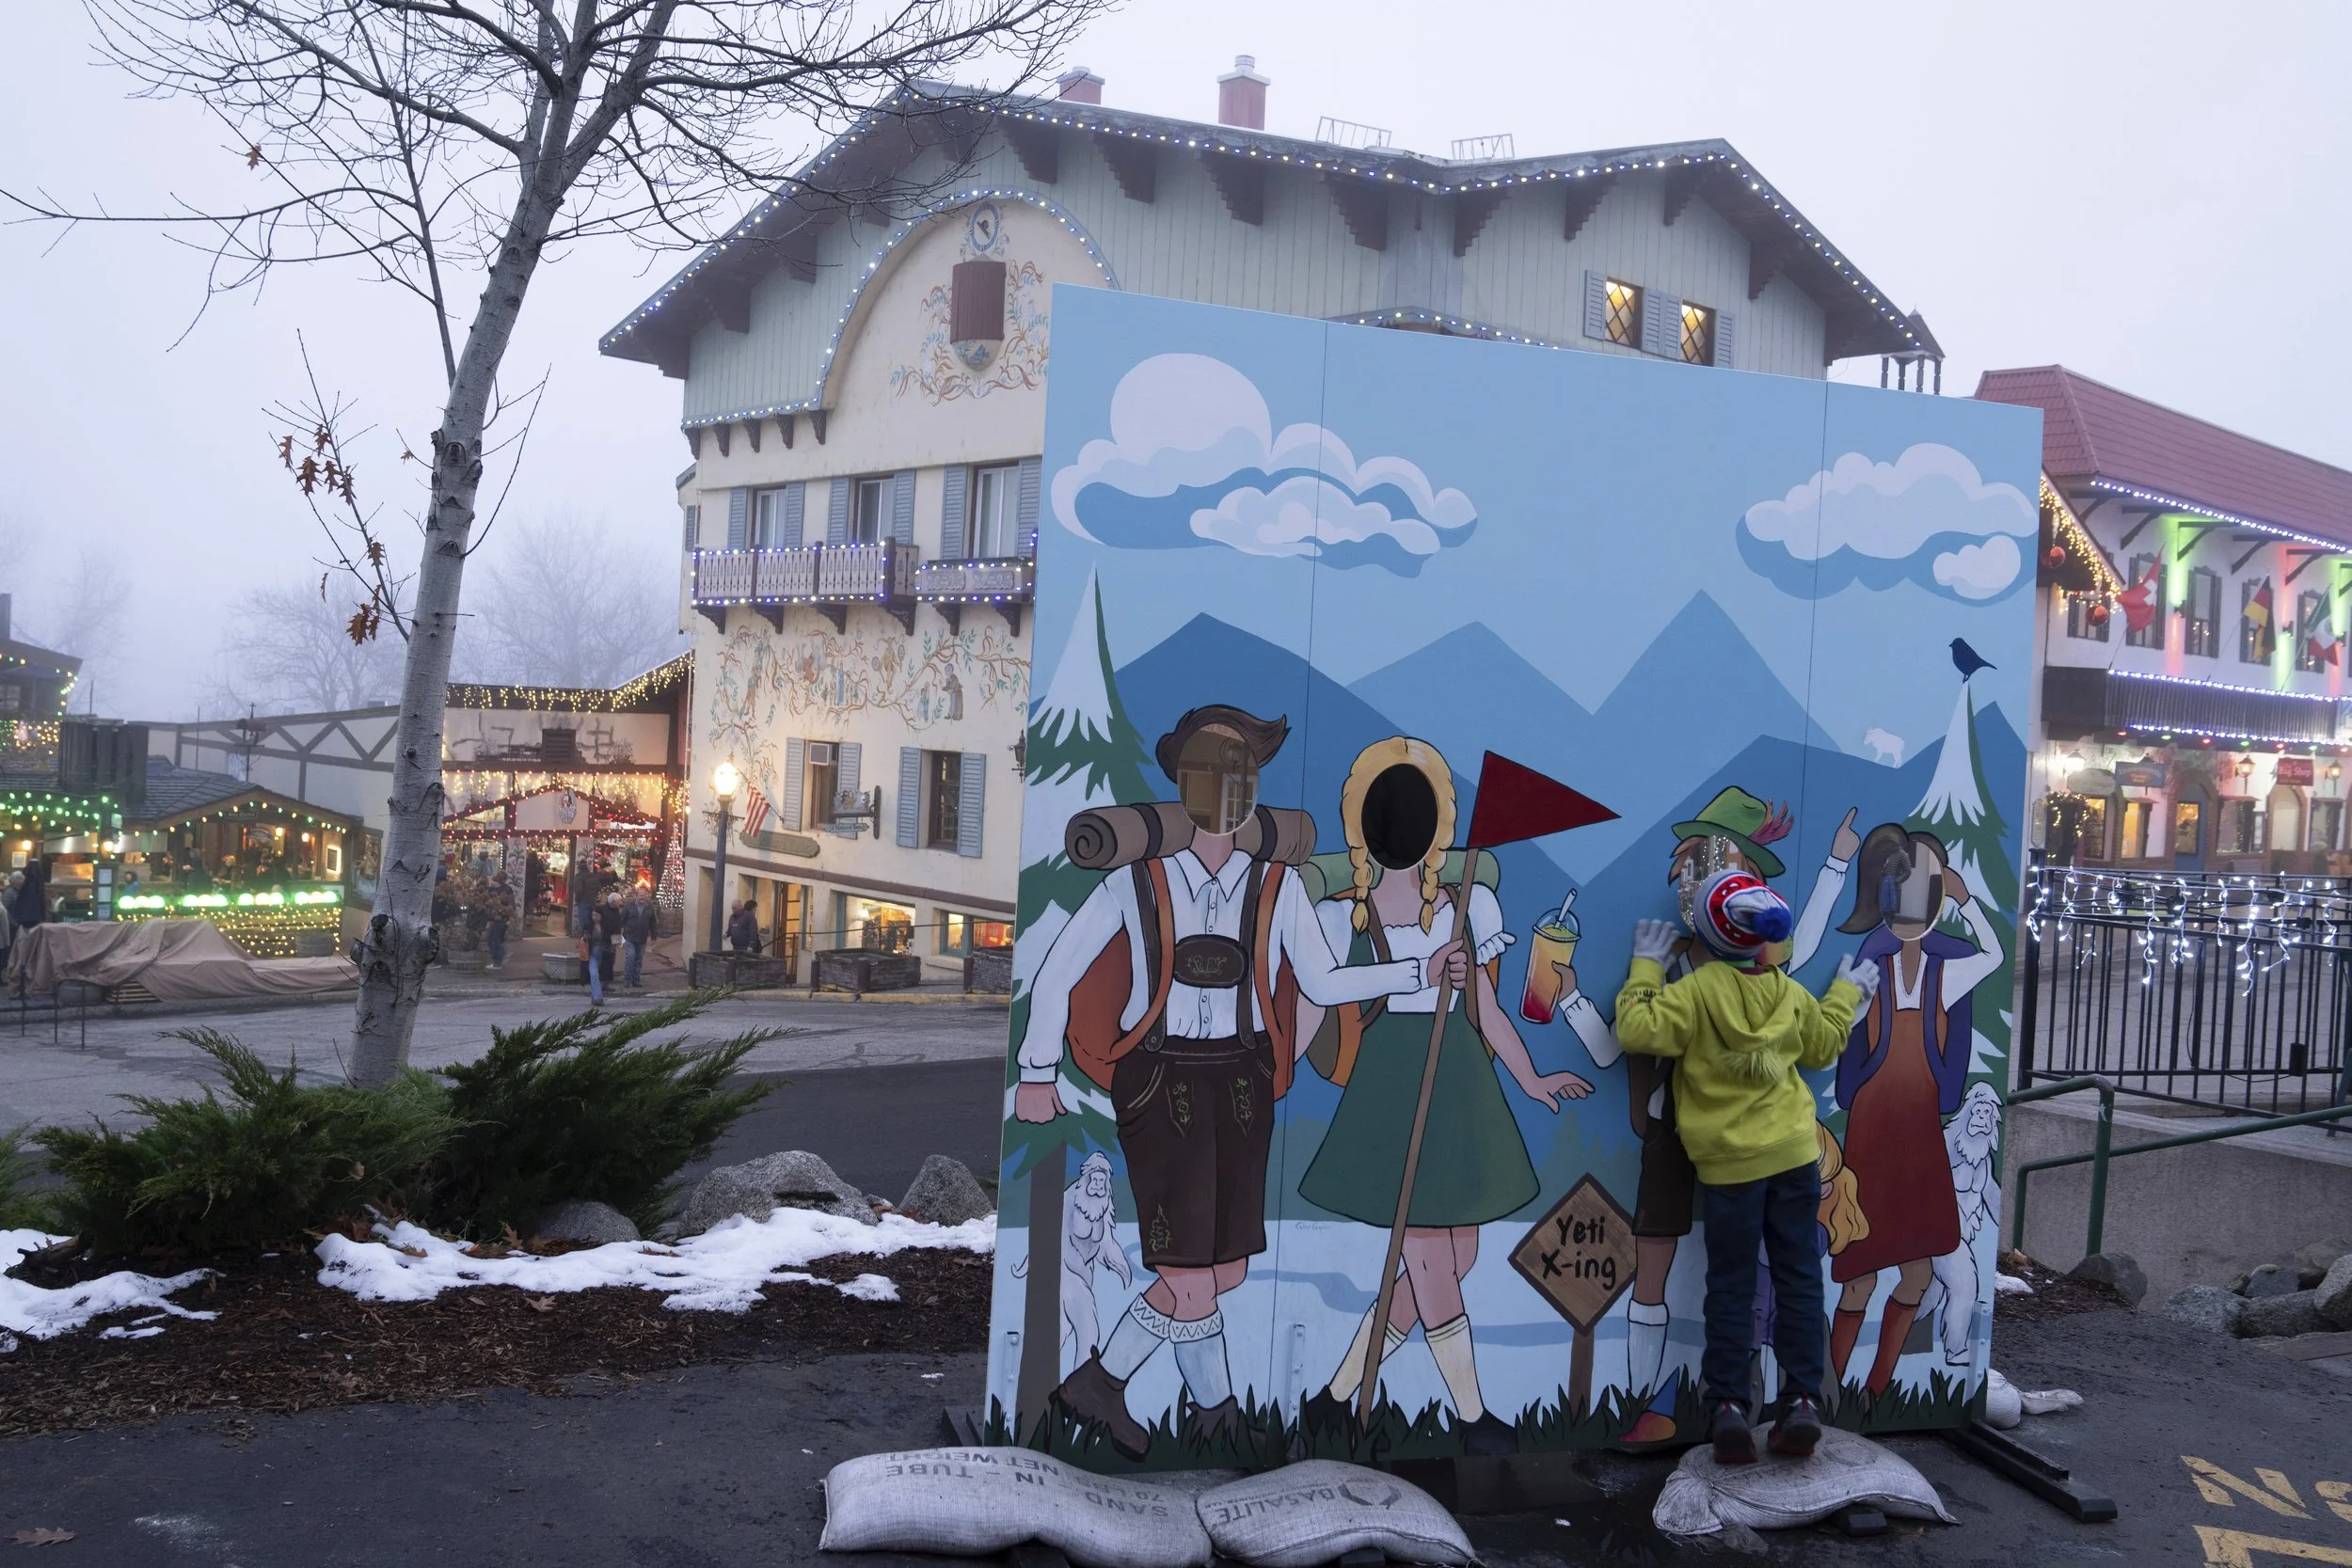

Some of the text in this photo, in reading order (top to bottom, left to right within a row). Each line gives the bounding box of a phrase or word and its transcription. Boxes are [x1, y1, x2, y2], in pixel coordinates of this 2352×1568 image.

[1556, 1214, 1606, 1246] Yeti
[1541, 1249, 1616, 1291] X-ing
[884, 1451, 998, 1465] WEIGHT
[1007, 1456, 1059, 1476] NET
[886, 1464, 974, 1479] TUBE
[1015, 1471, 1044, 1485] IN
[1085, 1492, 1168, 1517] SAND
[1136, 1491, 1165, 1503] 70
